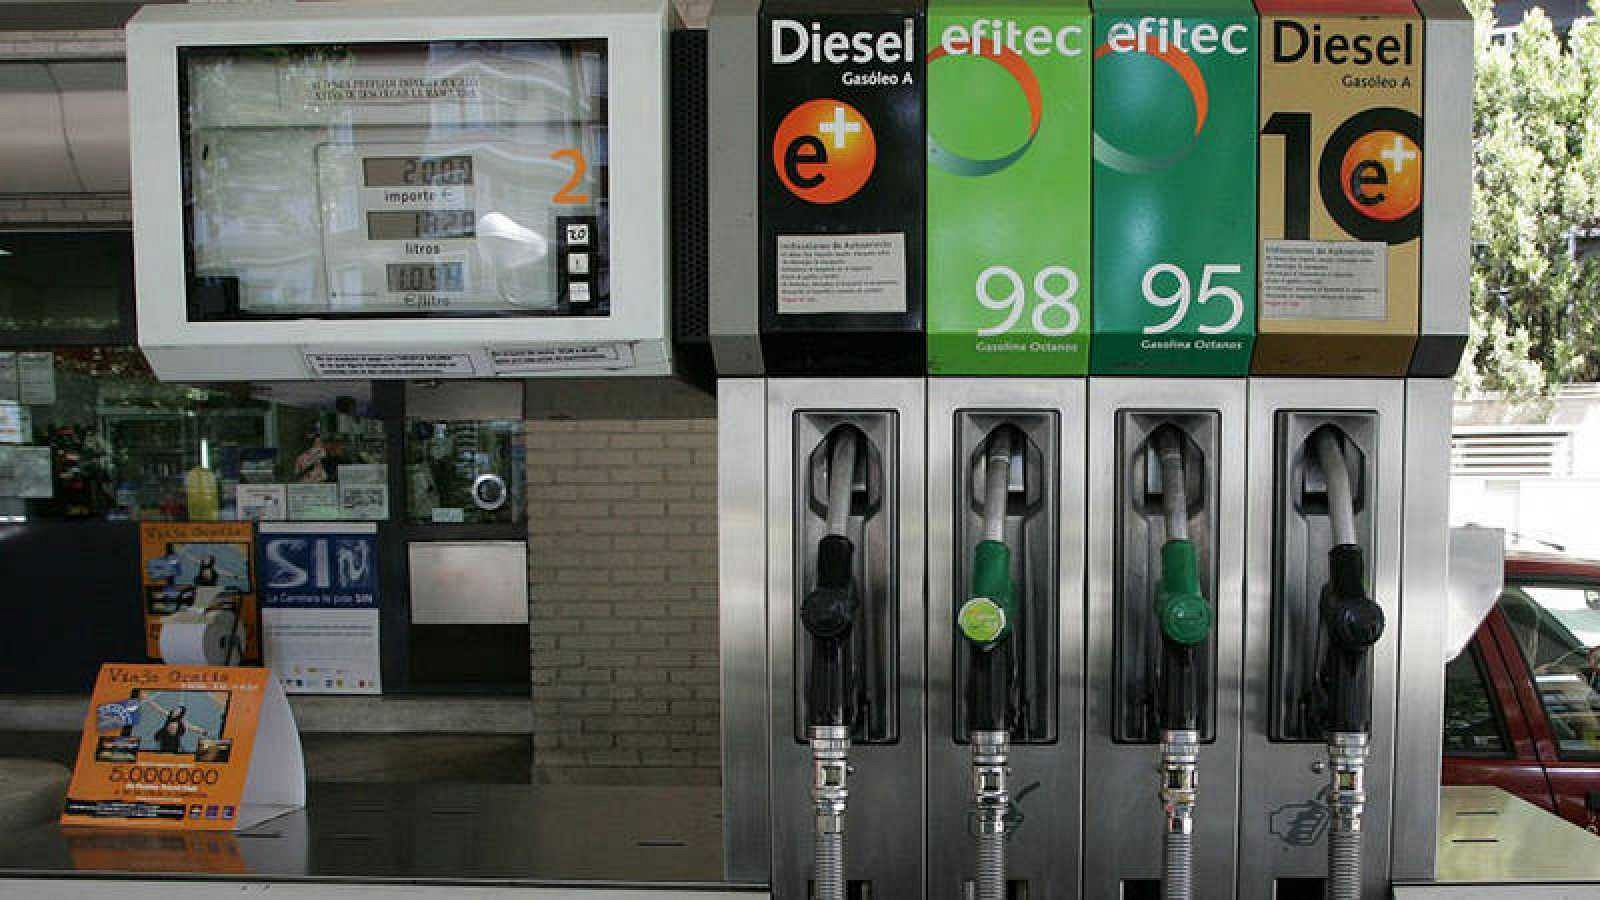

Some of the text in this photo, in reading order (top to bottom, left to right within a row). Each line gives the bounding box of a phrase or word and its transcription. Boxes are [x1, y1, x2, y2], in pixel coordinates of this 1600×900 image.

[771, 18, 914, 65] Diesel
[941, 18, 1082, 56] efitec
[1107, 17, 1249, 54] efitec
[1272, 19, 1413, 65] Diesel
[842, 71, 913, 85] Gasóleo A
[1401, 75, 1411, 87] A
[551, 149, 589, 204] 2
[405, 243, 441, 255] litros
[975, 265, 1079, 337] 98
[1141, 263, 1244, 335] 95
